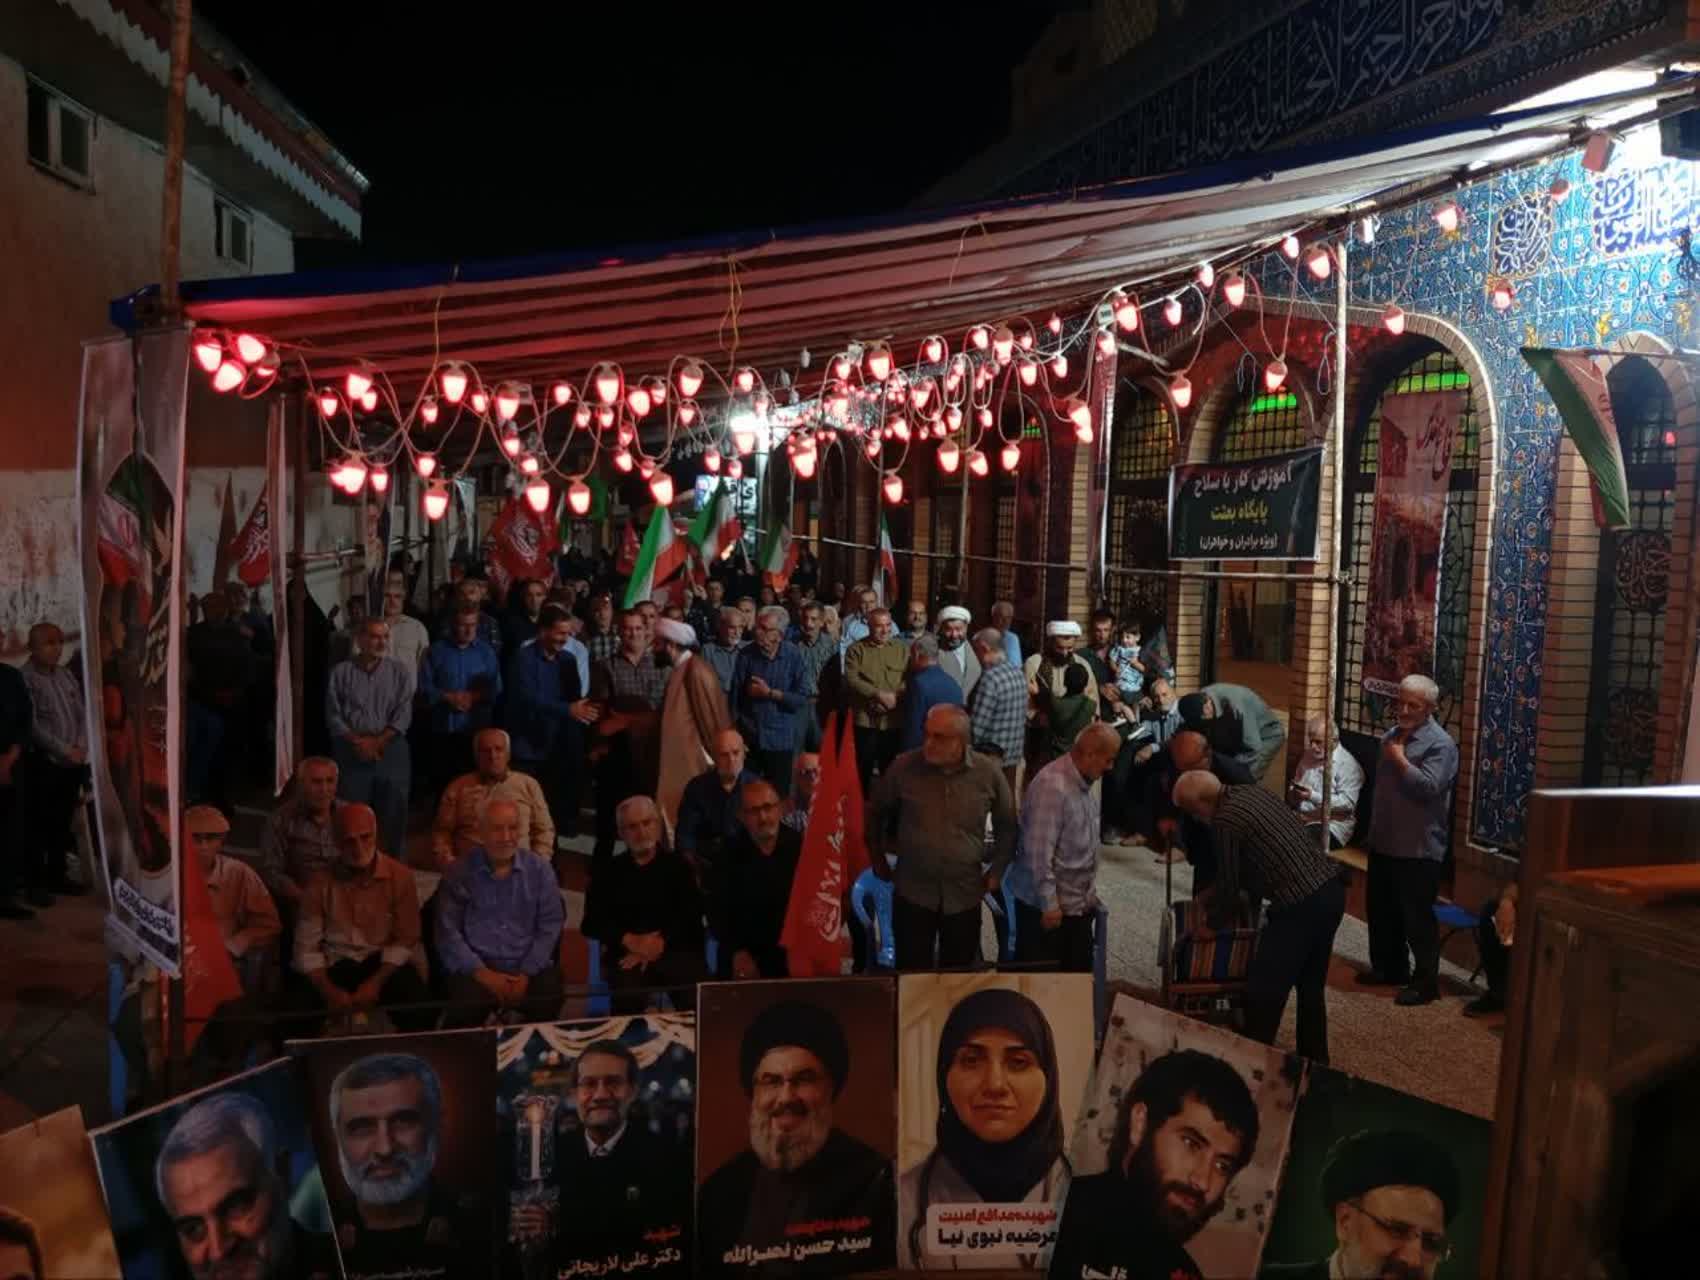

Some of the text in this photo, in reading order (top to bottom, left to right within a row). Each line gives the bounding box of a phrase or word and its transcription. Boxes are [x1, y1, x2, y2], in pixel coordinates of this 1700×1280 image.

[1193, 459, 1295, 499] آموزش کار با سلاح
[1239, 498, 1268, 525] پایگاه
[723, 1236, 871, 1266] سید حسن نصرالله
[939, 1228, 962, 1248] نیا
[967, 1228, 1002, 1249] نبوی
[558, 1247, 682, 1280] دکتر علی لاریجانی
